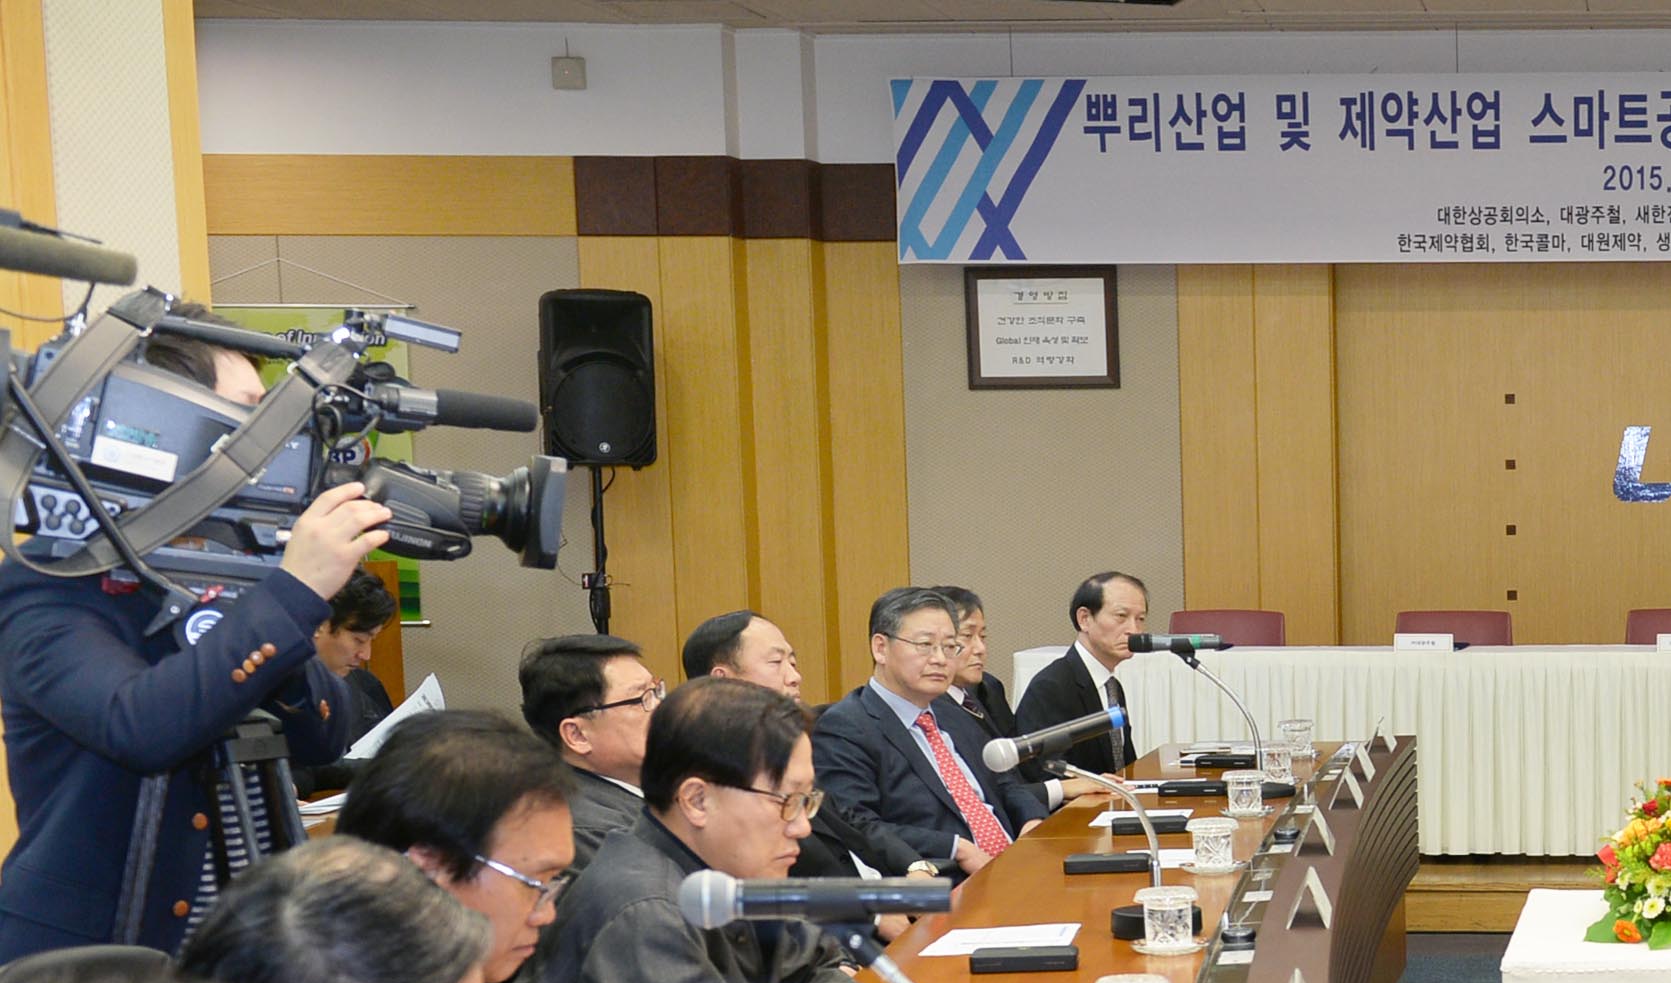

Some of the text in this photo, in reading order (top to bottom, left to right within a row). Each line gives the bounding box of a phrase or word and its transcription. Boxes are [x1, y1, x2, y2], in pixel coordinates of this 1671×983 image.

[1081, 90, 1247, 153] 뿌리산업
[1275, 90, 1312, 152] 및
[1338, 89, 1501, 152] 제약산업
[1603, 164, 1671, 193] 2015.
[1437, 205, 1551, 226] 대한상공회의소,
[1559, 204, 1627, 226] 대광주철,
[1397, 232, 1496, 254] 한국제약협회,
[1504, 232, 1571, 253] 한국콜마,
[1580, 231, 1647, 253] 대원제약,
[995, 335, 1022, 345] Global
